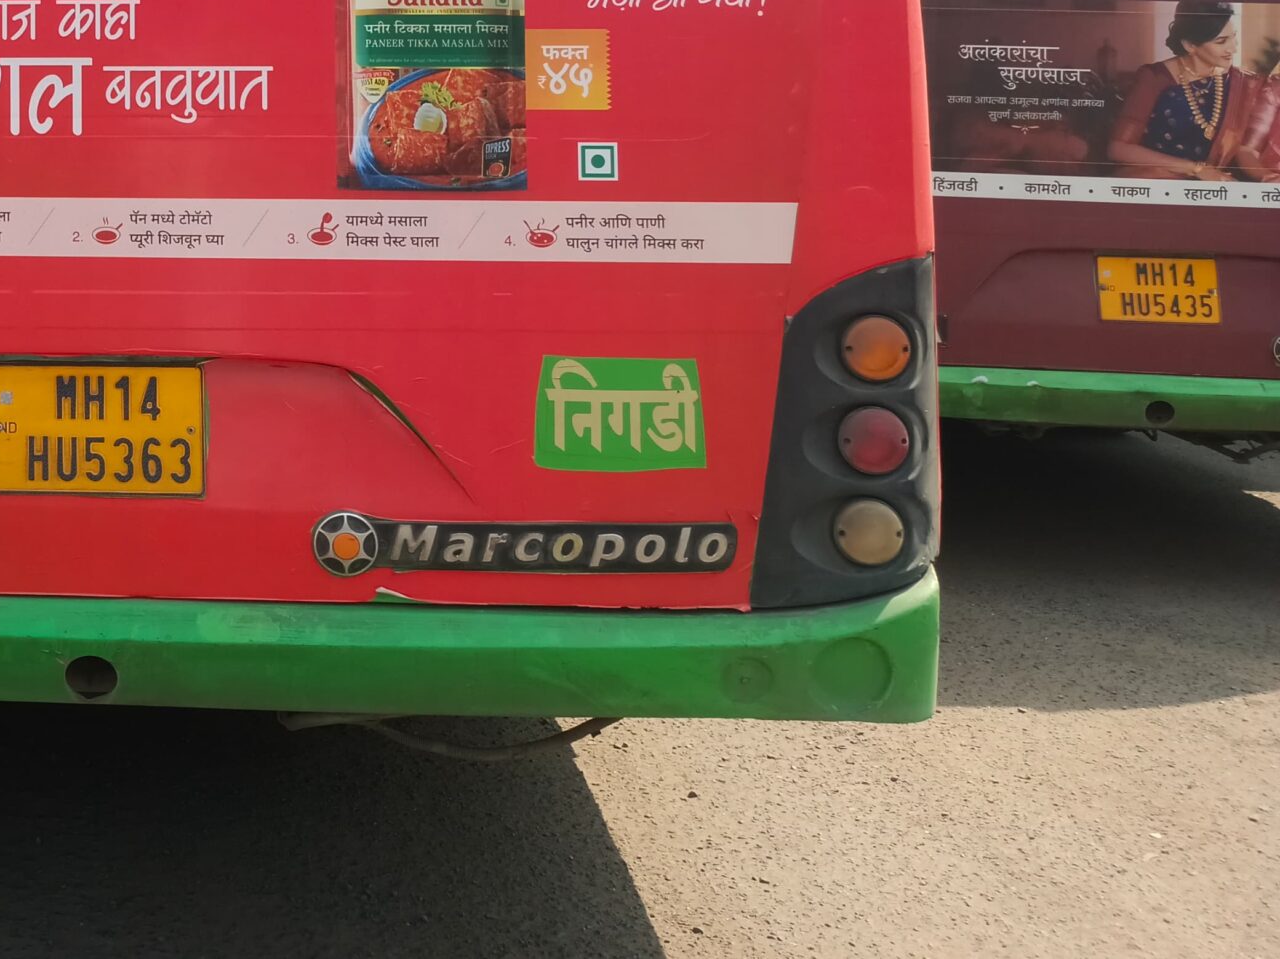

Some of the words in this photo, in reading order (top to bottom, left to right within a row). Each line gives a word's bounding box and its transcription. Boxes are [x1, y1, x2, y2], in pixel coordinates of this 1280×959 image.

[364, 20, 391, 35] पनीर
[394, 19, 430, 35] टिक्का
[434, 23, 472, 35] मसाला
[475, 19, 510, 35] मिक्स
[365, 39, 404, 49] PANEER
[408, 39, 439, 49] TIKKA
[442, 39, 484, 49] MASALA
[487, 39, 510, 49] MIX
[541, 43, 589, 61] फक्त
[958, 40, 1060, 62] अलंकारांचा
[998, 62, 1091, 90] सुवर्णसाज
[933, 176, 978, 193] हिंजवडी
[1025, 180, 1071, 197] कामशेत
[1111, 184, 1151, 200] चाकण
[1184, 185, 1228, 202] रहाटणी
[130, 209, 147, 225] पॅन
[151, 210, 176, 225] मध्ये
[346, 211, 384, 228] यामध्ये
[388, 214, 428, 229] मसाला
[566, 212, 595, 229] पनीर
[600, 212, 632, 229] आणि
[636, 212, 665, 230] पाणी
[158, 230, 201, 250] शिजवून
[346, 232, 379, 248] मिक्स
[384, 231, 407, 249] पेस्ट
[411, 235, 439, 249] घाला
[605, 233, 638, 250] चांगले
[643, 233, 676, 251] मिक्स
[681, 237, 704, 251] करा
[1121, 292, 1213, 318] HU5435
[545, 358, 699, 453] निगडी
[28, 435, 191, 484] HU5363
[390, 524, 728, 568] Marcopolo
